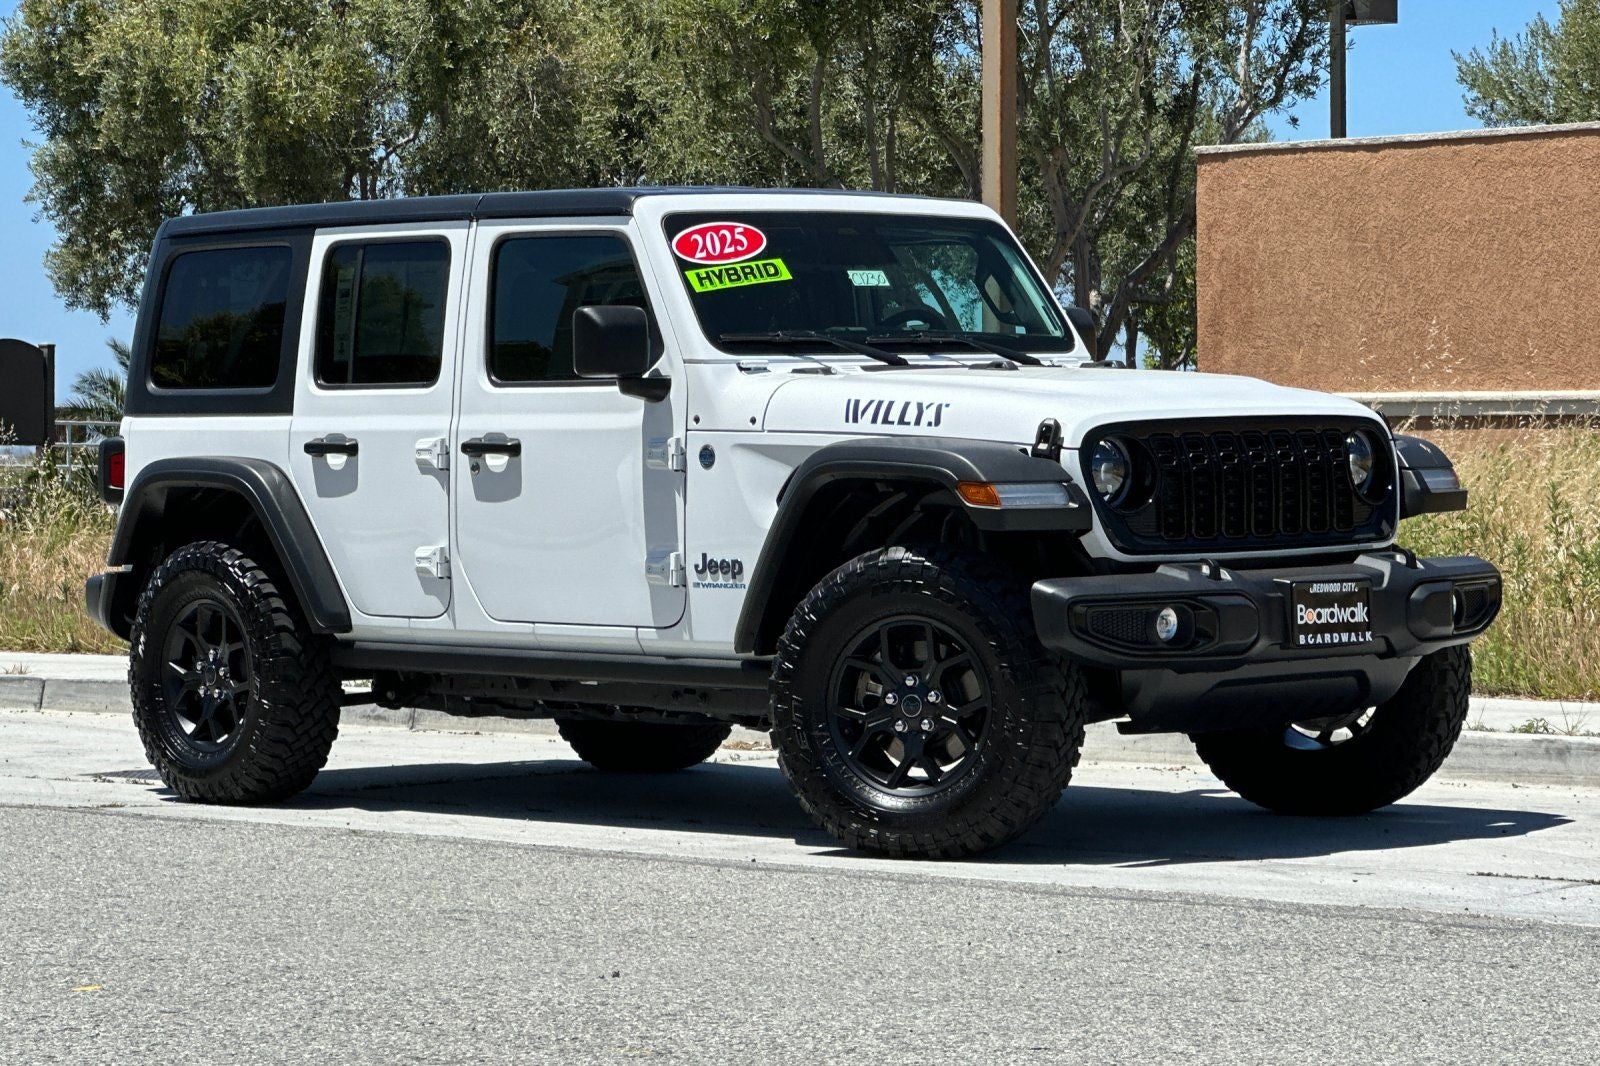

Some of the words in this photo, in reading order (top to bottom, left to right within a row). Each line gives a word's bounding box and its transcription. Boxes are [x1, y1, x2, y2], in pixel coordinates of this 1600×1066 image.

[690, 227, 748, 259] 2025
[694, 262, 783, 288] HYBRID
[844, 398, 951, 428] WILLYS
[693, 552, 744, 580] Jeep
[701, 582, 747, 590] WRANGLER
[1312, 582, 1341, 593] REDWOOD
[1342, 582, 1357, 593] CITY
[1296, 602, 1369, 625] Boardwalk
[1299, 631, 1373, 645] BOARDWALK
